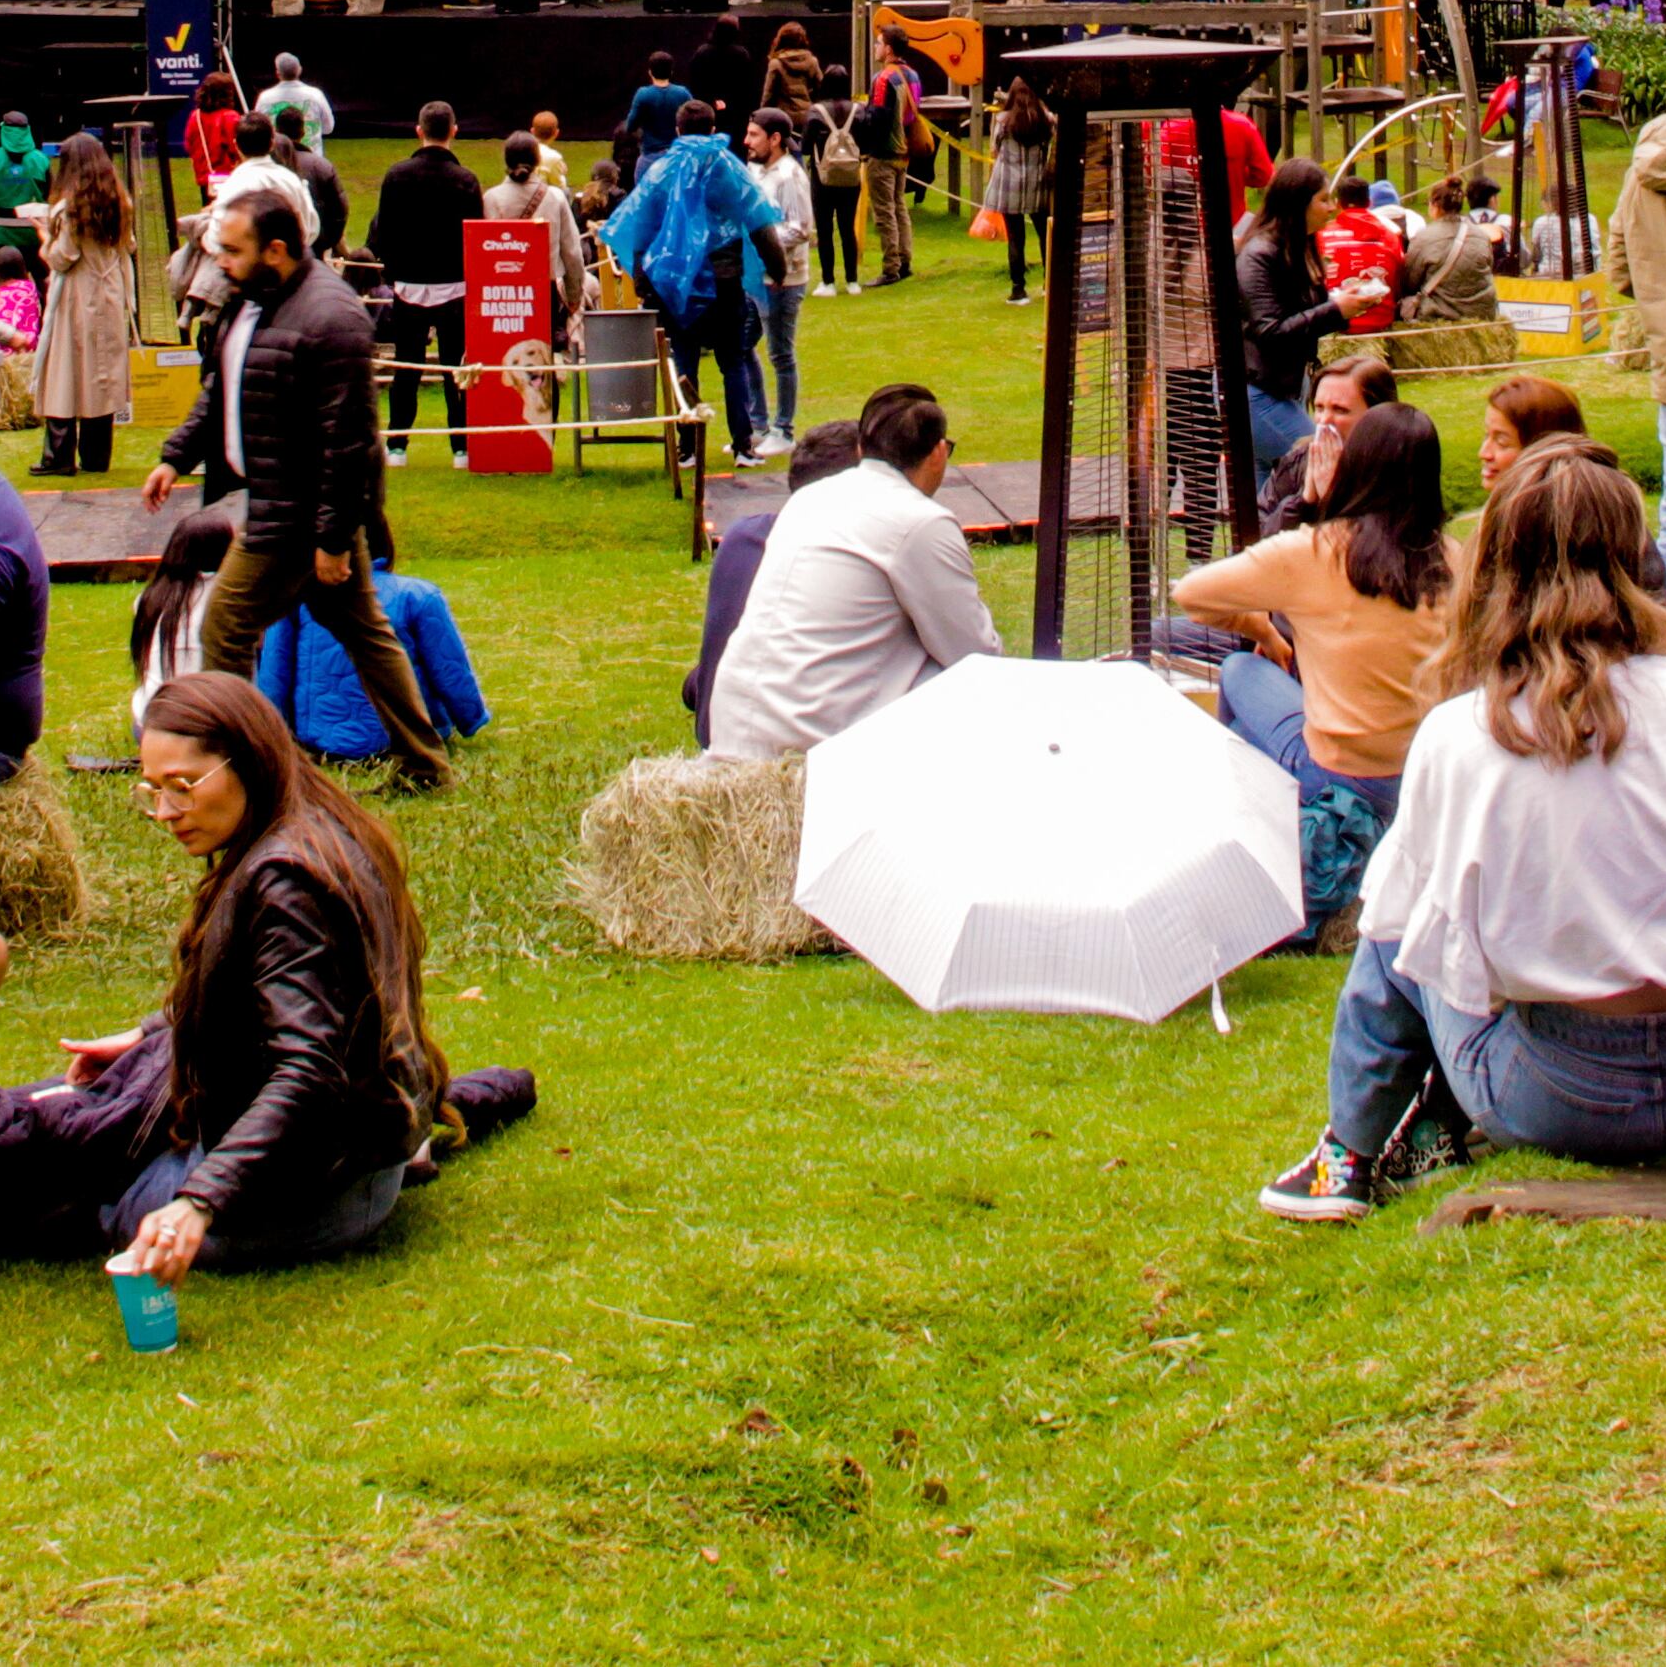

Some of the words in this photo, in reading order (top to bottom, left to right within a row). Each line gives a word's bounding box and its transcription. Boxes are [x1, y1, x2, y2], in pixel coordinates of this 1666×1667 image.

[156, 54, 200, 69] vanti
[483, 240, 530, 253] Chunky
[484, 286, 516, 300] BOTA
[518, 286, 534, 300] LA
[481, 301, 533, 316] BASURA
[493, 316, 524, 333] AQUÍ
